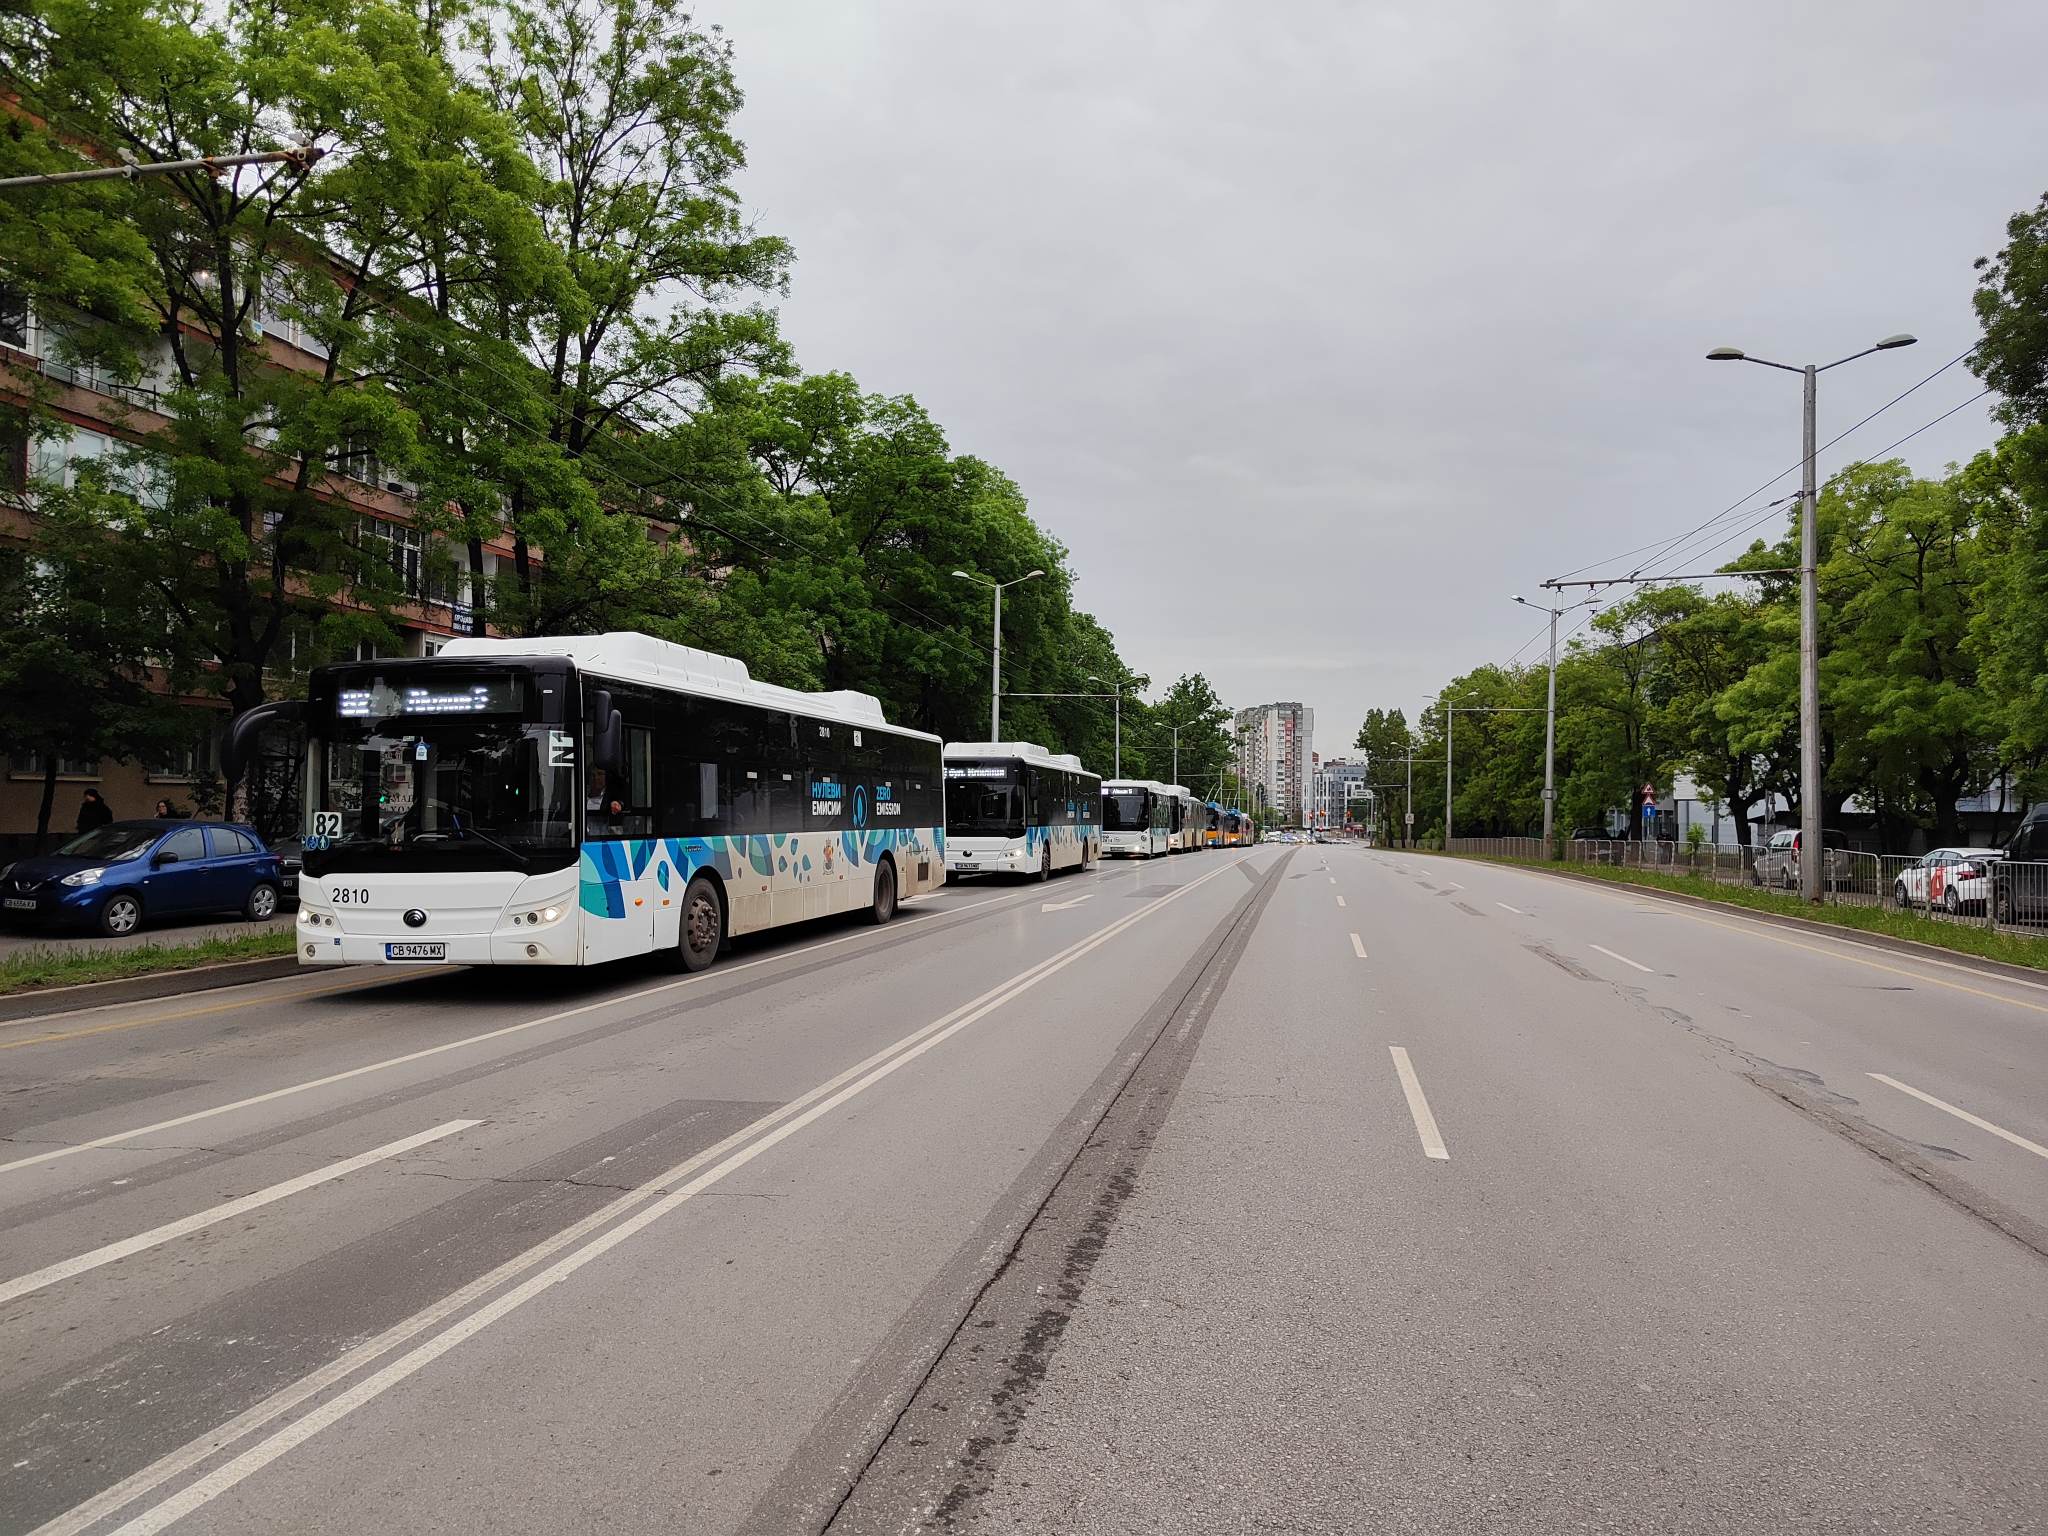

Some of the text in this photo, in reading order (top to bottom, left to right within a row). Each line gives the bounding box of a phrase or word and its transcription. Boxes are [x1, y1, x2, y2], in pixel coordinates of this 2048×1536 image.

[812, 782, 841, 798] НУЛЕВИ
[876, 786, 891, 800] ZERO
[812, 801, 841, 815] ЕМИСИИ
[876, 803, 900, 815] EMISSION
[315, 813, 339, 837] 82
[332, 888, 370, 904] 2810
[392, 945, 442, 956] CB 9476 MX
